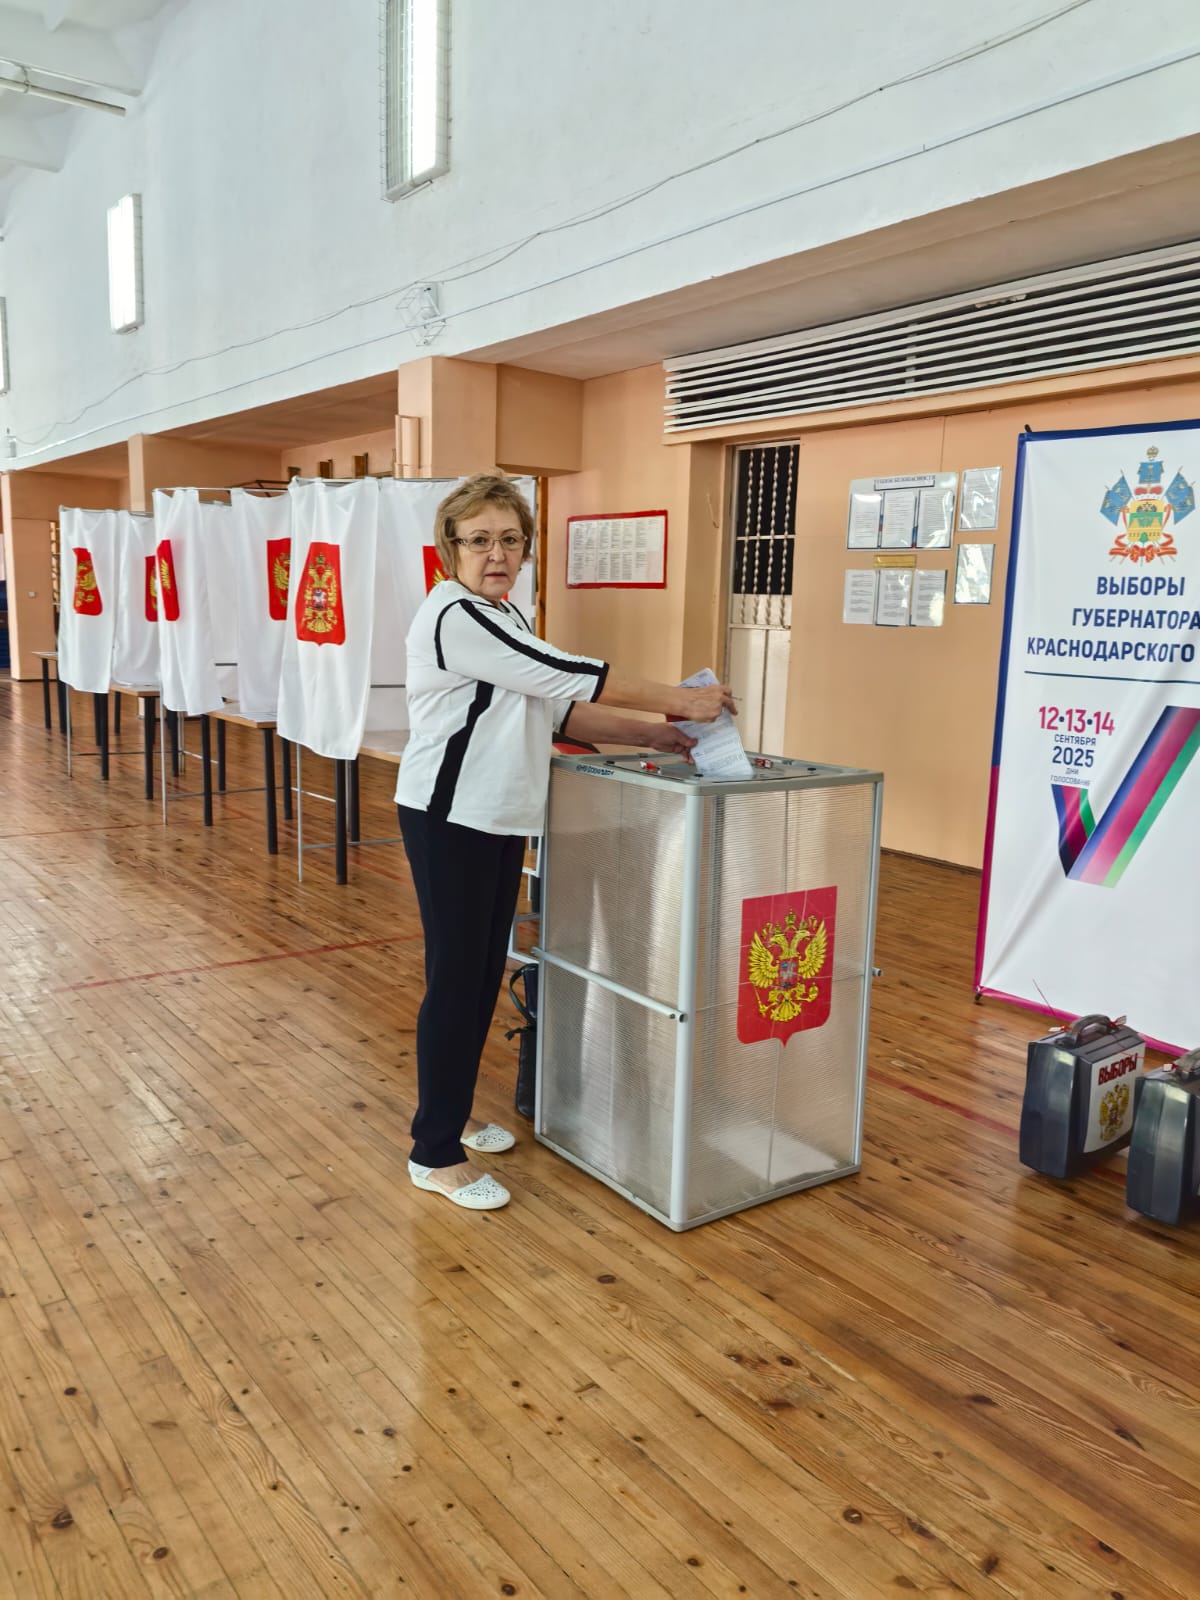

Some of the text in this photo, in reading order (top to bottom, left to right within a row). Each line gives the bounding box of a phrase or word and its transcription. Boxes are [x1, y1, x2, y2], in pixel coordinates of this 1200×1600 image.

[1096, 576, 1185, 596] ВЫБОРЫ
[1072, 608, 1200, 630] ГУБЕРНАТОРА
[1027, 637, 1195, 662] КРАСНОДАРСКОГО
[1054, 734, 1096, 746] СЕНТЯБРЯ
[1052, 745, 1094, 768] 2025
[1098, 1052, 1138, 1086] ВЫБОРЫ
